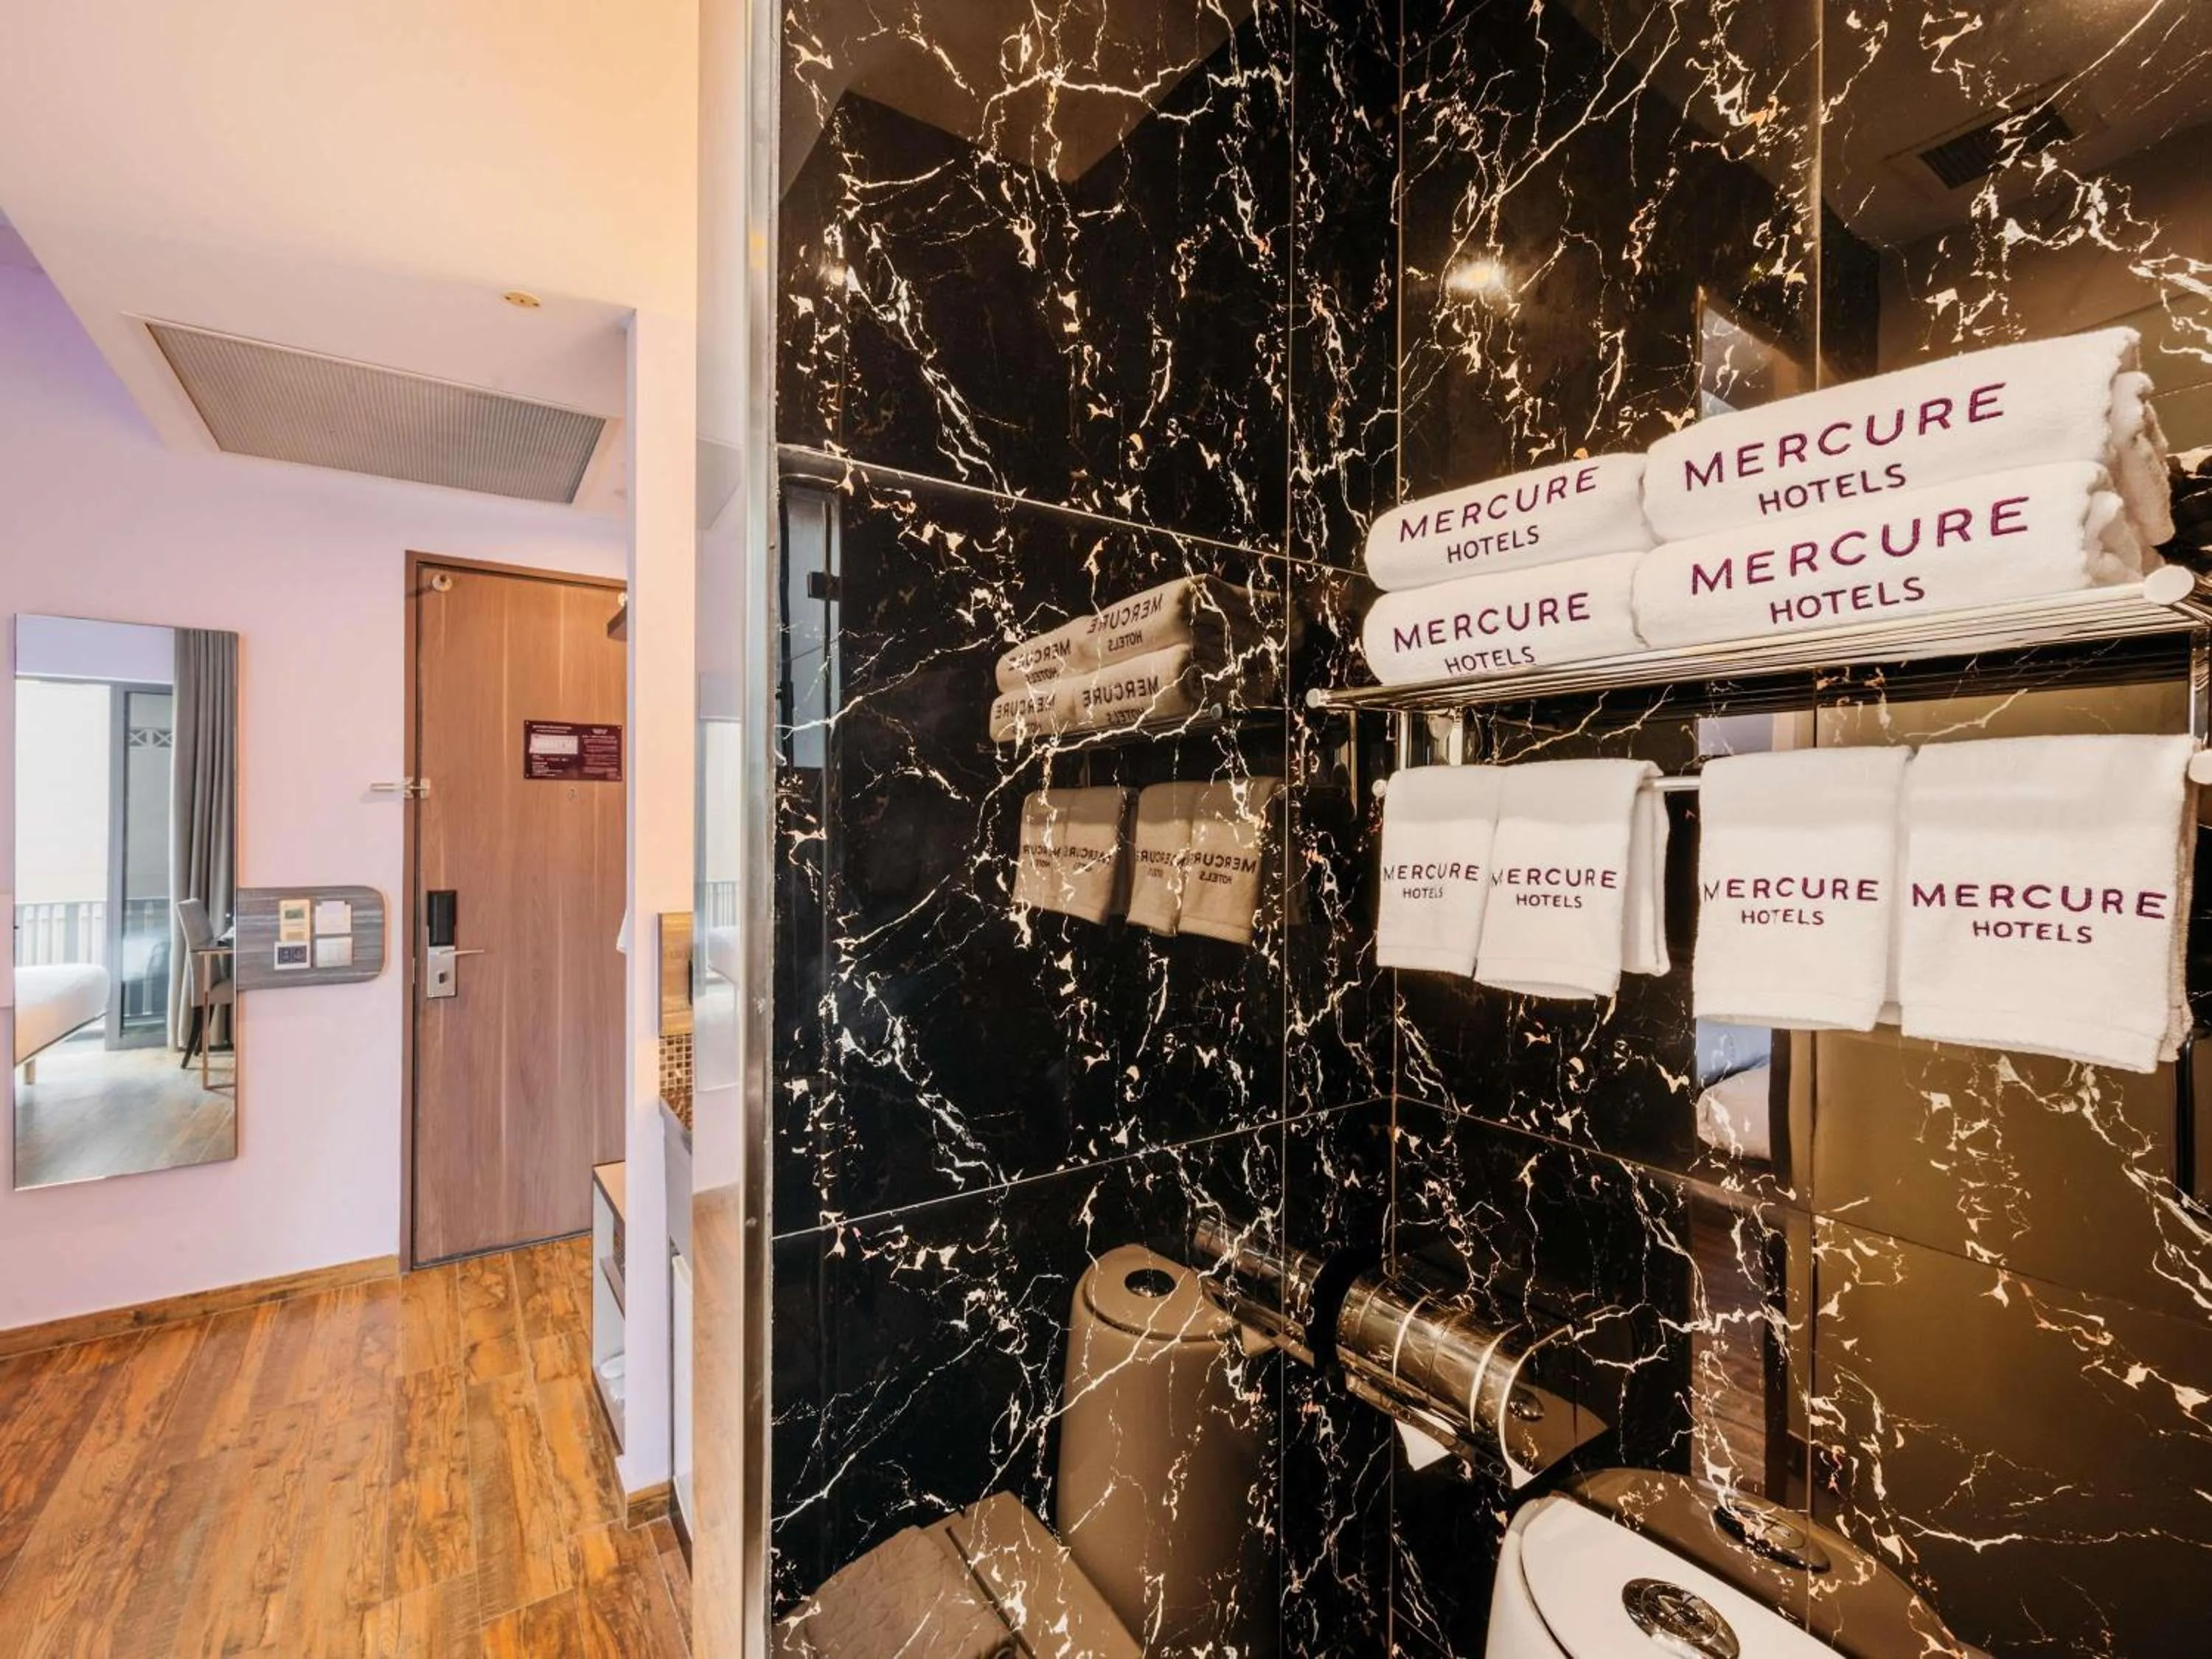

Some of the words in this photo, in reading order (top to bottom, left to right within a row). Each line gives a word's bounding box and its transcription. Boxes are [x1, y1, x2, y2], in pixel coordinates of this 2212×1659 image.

[1685, 382, 2007, 491] MERCURE
[1399, 467, 1599, 543] MERCURE
[1759, 463, 1907, 515] HOTELS
[1447, 525, 1540, 563] HOTELS
[1691, 495, 2030, 595] MERCURE
[1770, 576, 1925, 625] HOTELS
[1393, 592, 1591, 653] MERCURE
[1444, 647, 1536, 675] HOTELS
[1383, 862, 1481, 882] MERCURE
[1490, 868, 1617, 889] MERCURE
[1403, 886, 1444, 900] HOTELS
[1516, 893, 1582, 908] HOTELS
[1703, 877, 1879, 902] MERCURE
[1911, 883, 2168, 920] MERCURE
[1741, 908, 1825, 926] HOTELS
[1973, 919, 2093, 944] HOTELS
